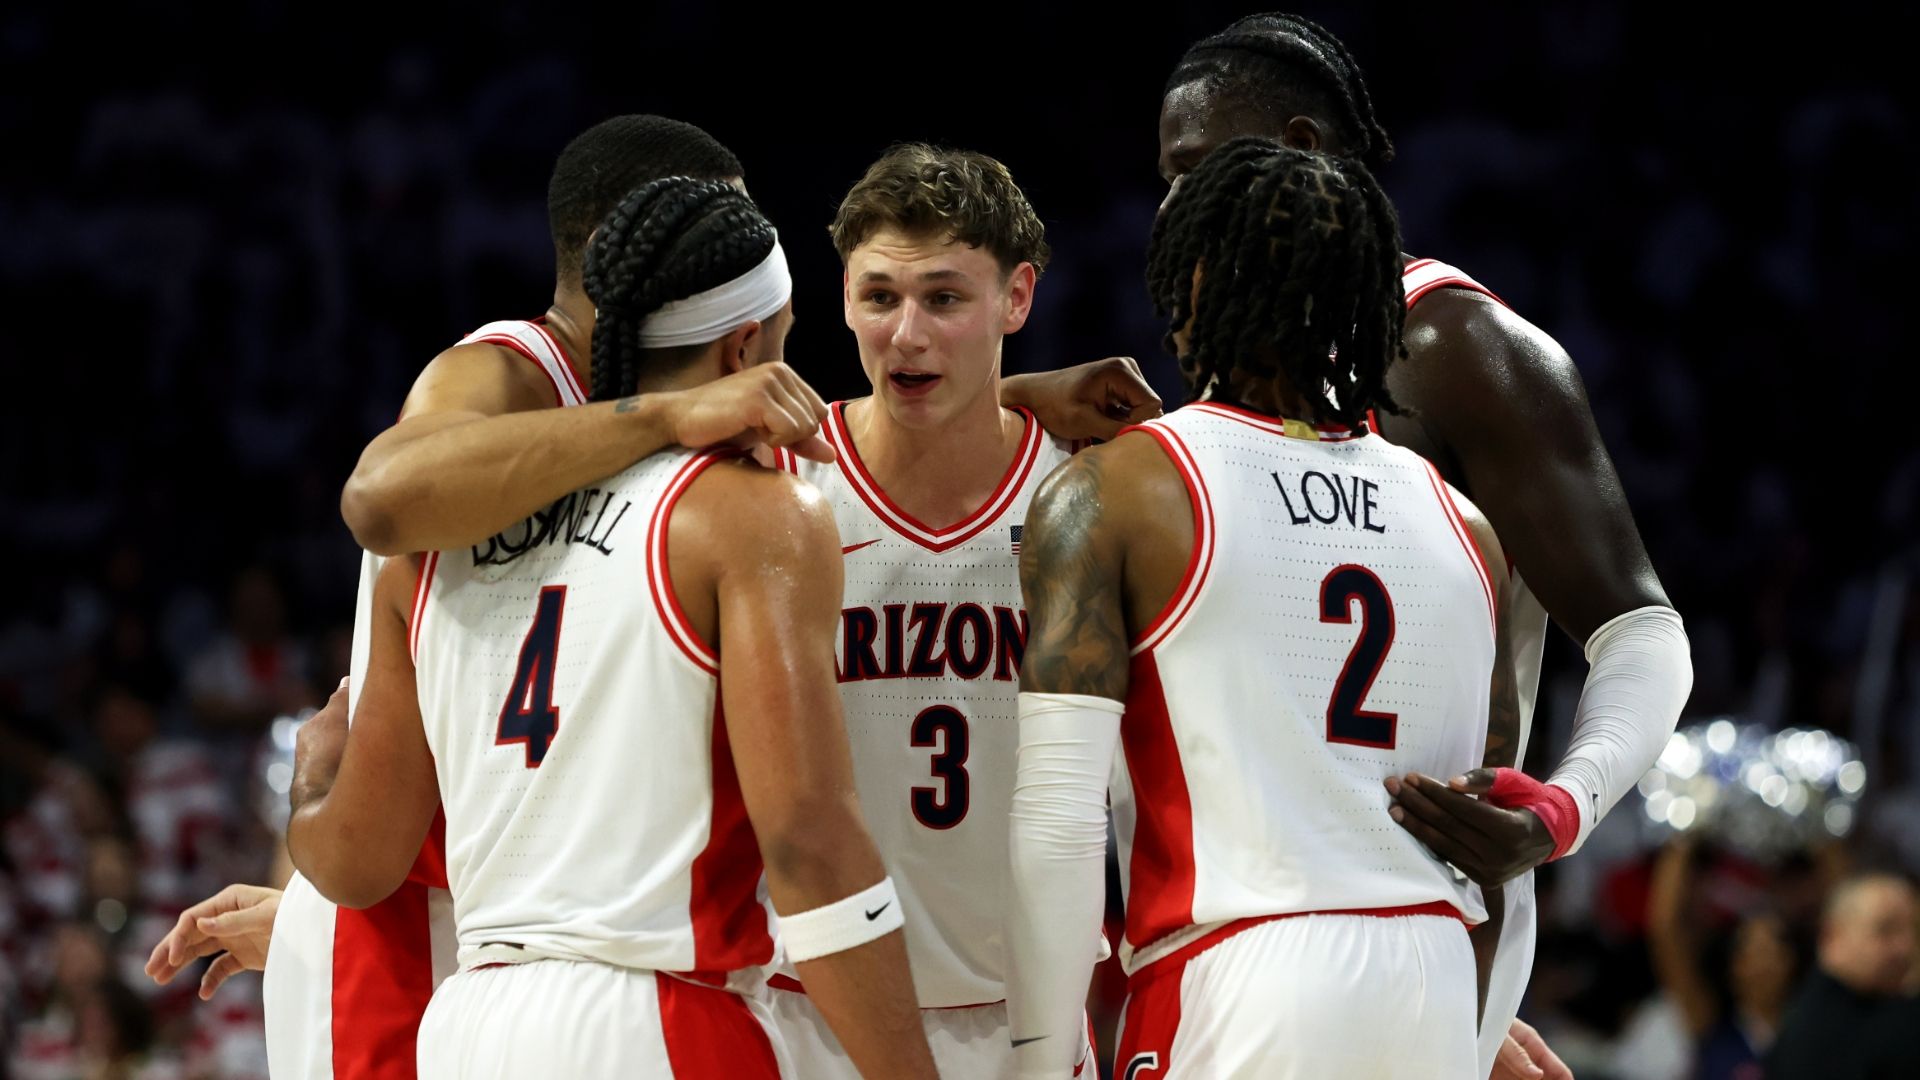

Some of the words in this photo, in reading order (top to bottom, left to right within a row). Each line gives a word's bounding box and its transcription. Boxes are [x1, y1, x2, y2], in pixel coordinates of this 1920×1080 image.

[1270, 470, 1386, 534] LOVE
[494, 584, 568, 769] 4
[834, 602, 1030, 683] RIZON
[1319, 563, 1398, 750] 2
[910, 704, 969, 830] 3
